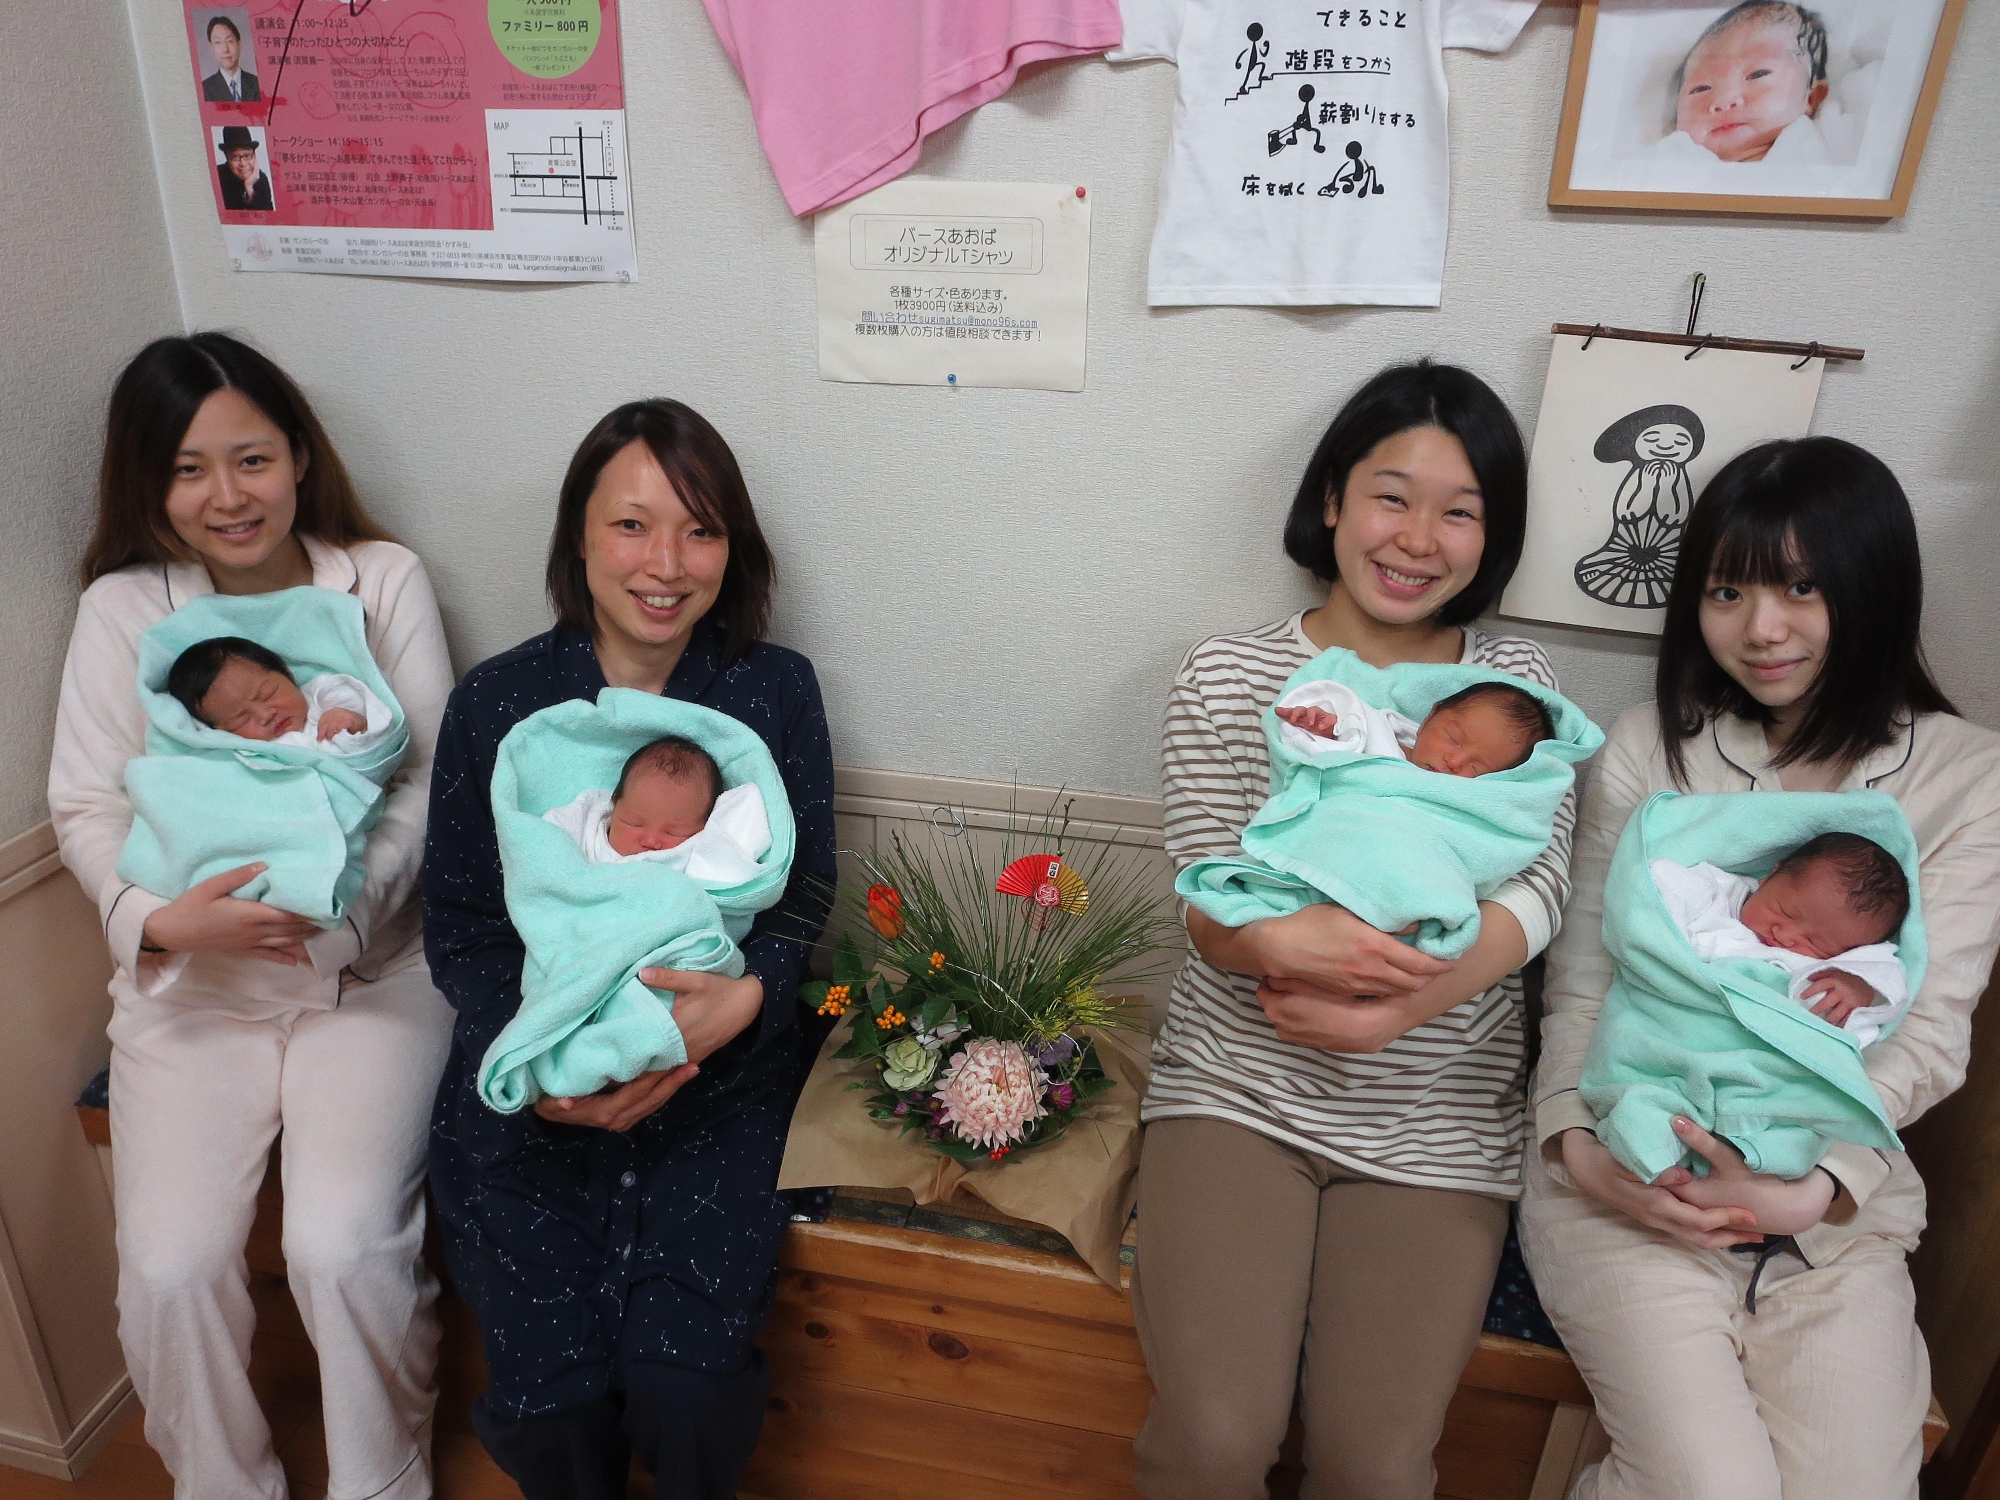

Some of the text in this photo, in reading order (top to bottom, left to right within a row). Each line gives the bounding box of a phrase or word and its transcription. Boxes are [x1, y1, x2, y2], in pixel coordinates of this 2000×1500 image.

[255, 17, 286, 30] 講演会
[1316, 10, 1407, 28] できること
[1285, 49, 1392, 71] 階段をつかう
[1318, 102, 1416, 128] 薪割りをする
[494, 122, 510, 130] MAP
[272, 136, 324, 146] トークショー
[1242, 174, 1305, 196] 床を拭く
[899, 226, 997, 246] バースあおば
[884, 246, 1014, 266] オリジナルTシャツ
[889, 286, 1008, 300] 各種サイズ・色あります。
[894, 300, 1004, 314] 1枚3900円（送料込み）
[855, 324, 1043, 342] 複数枚購入の方は値段相談できます！
